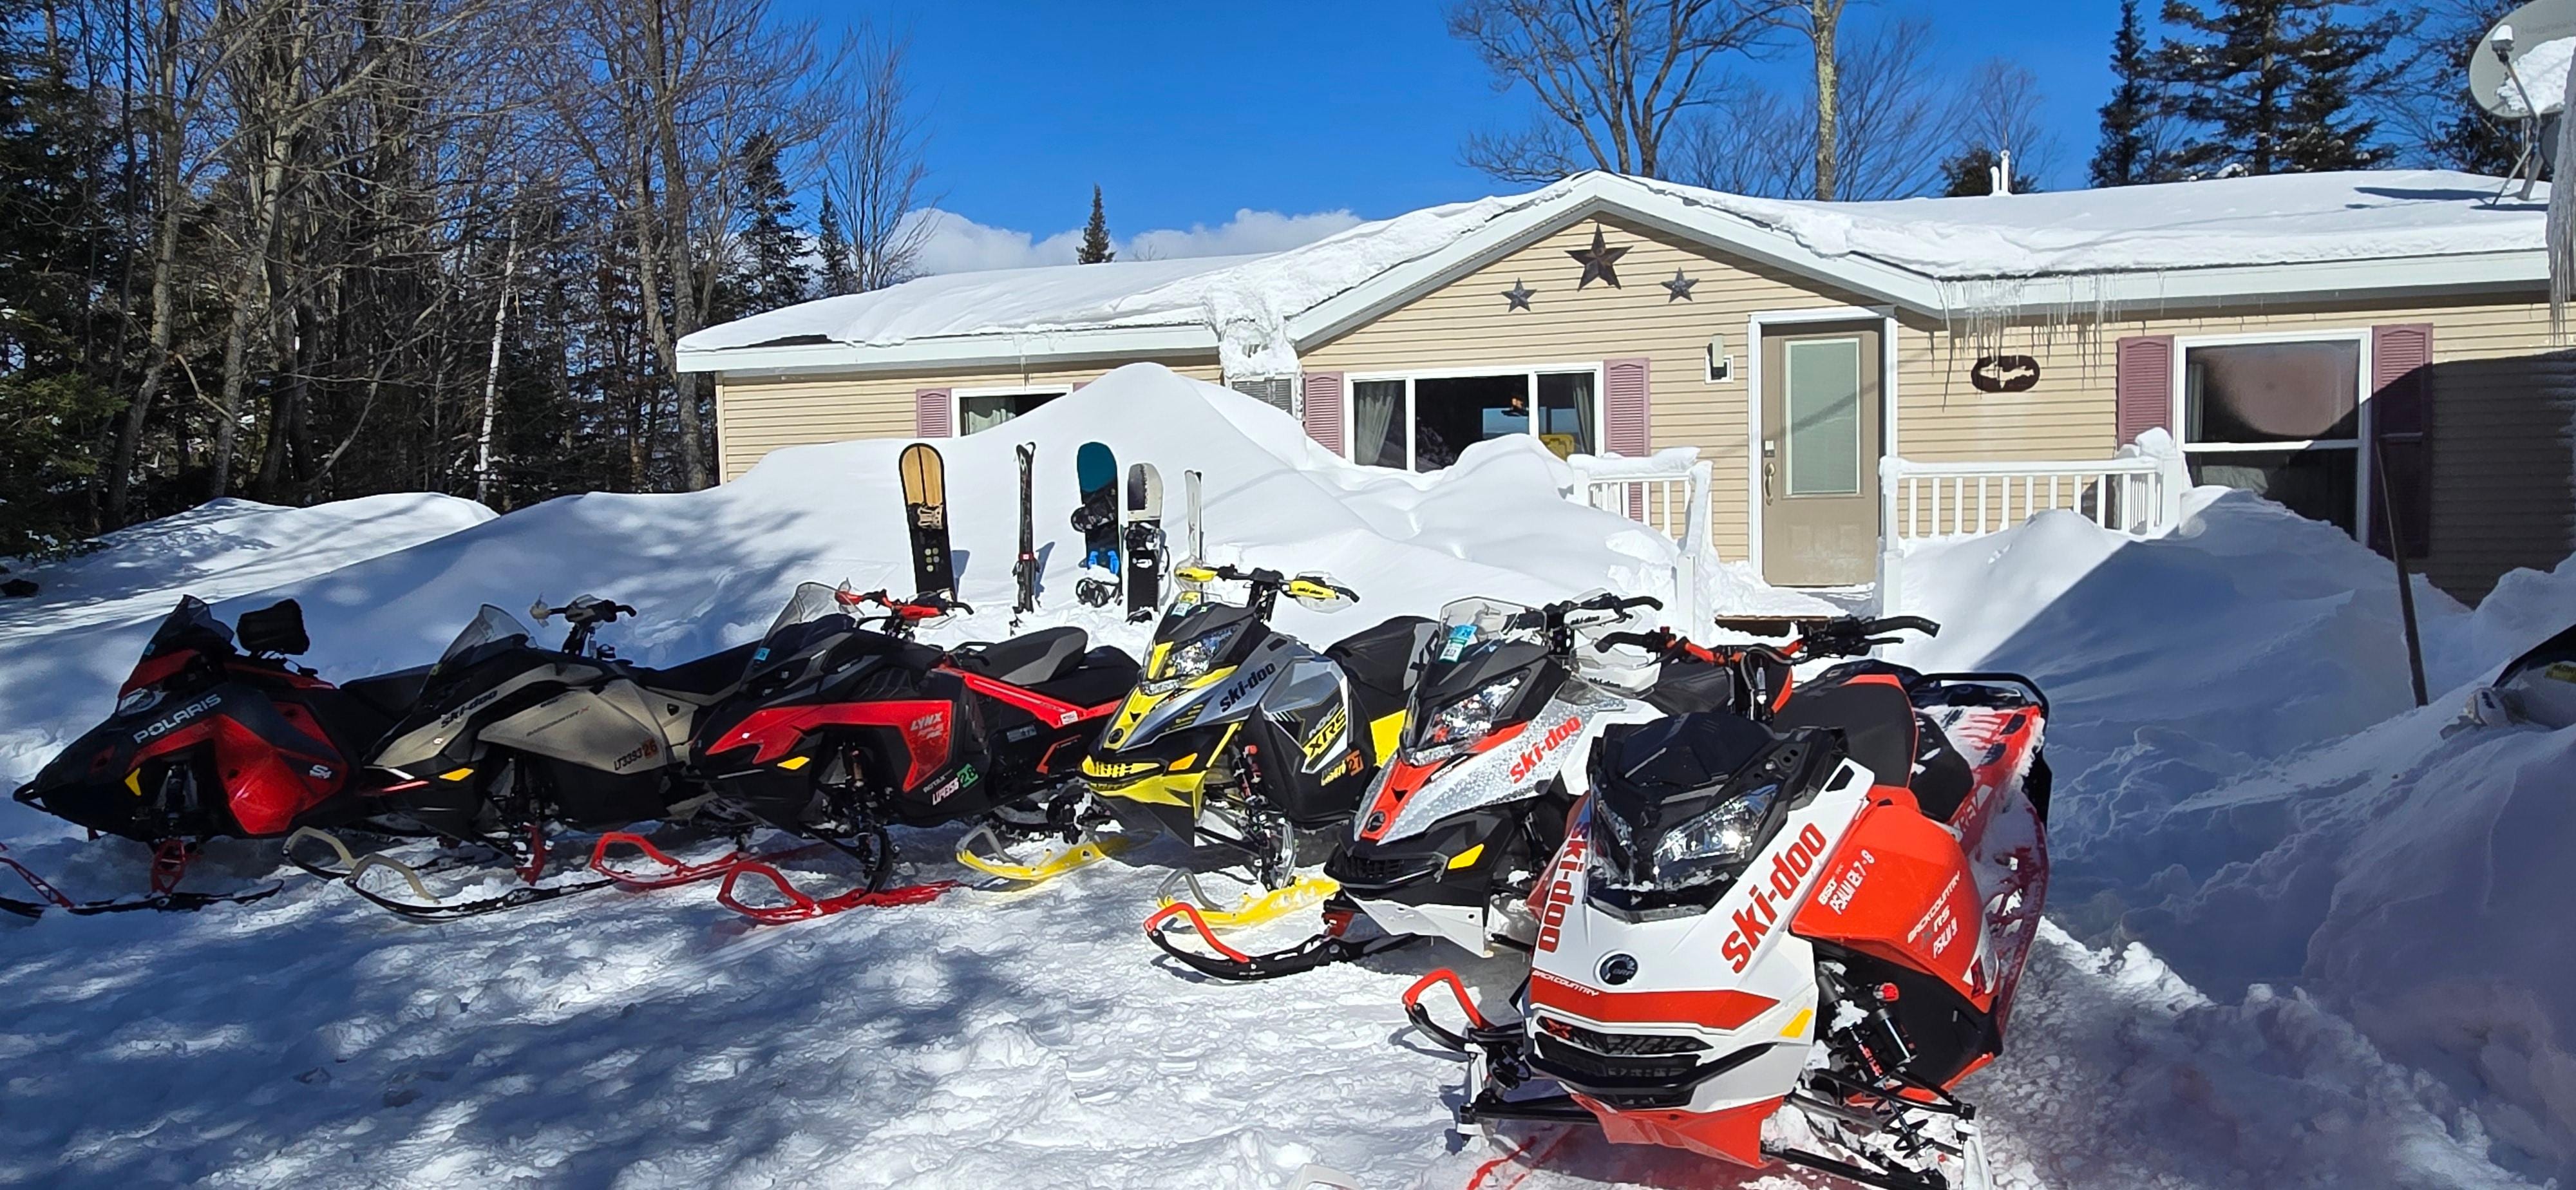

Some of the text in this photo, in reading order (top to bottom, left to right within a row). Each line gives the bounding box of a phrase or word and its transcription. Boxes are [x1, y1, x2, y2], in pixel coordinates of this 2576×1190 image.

[1220, 662, 1276, 712] ski-doo
[133, 693, 222, 744] POLARIS
[910, 711, 943, 732] LYNX
[1347, 754, 1361, 771] 27
[1510, 716, 1582, 784] ski-doo
[959, 766, 976, 785] 28
[1538, 822, 1591, 953] ski-doo
[1721, 822, 1827, 974] ski-doo
[1531, 970, 1600, 997] BACKCOUNTRY
